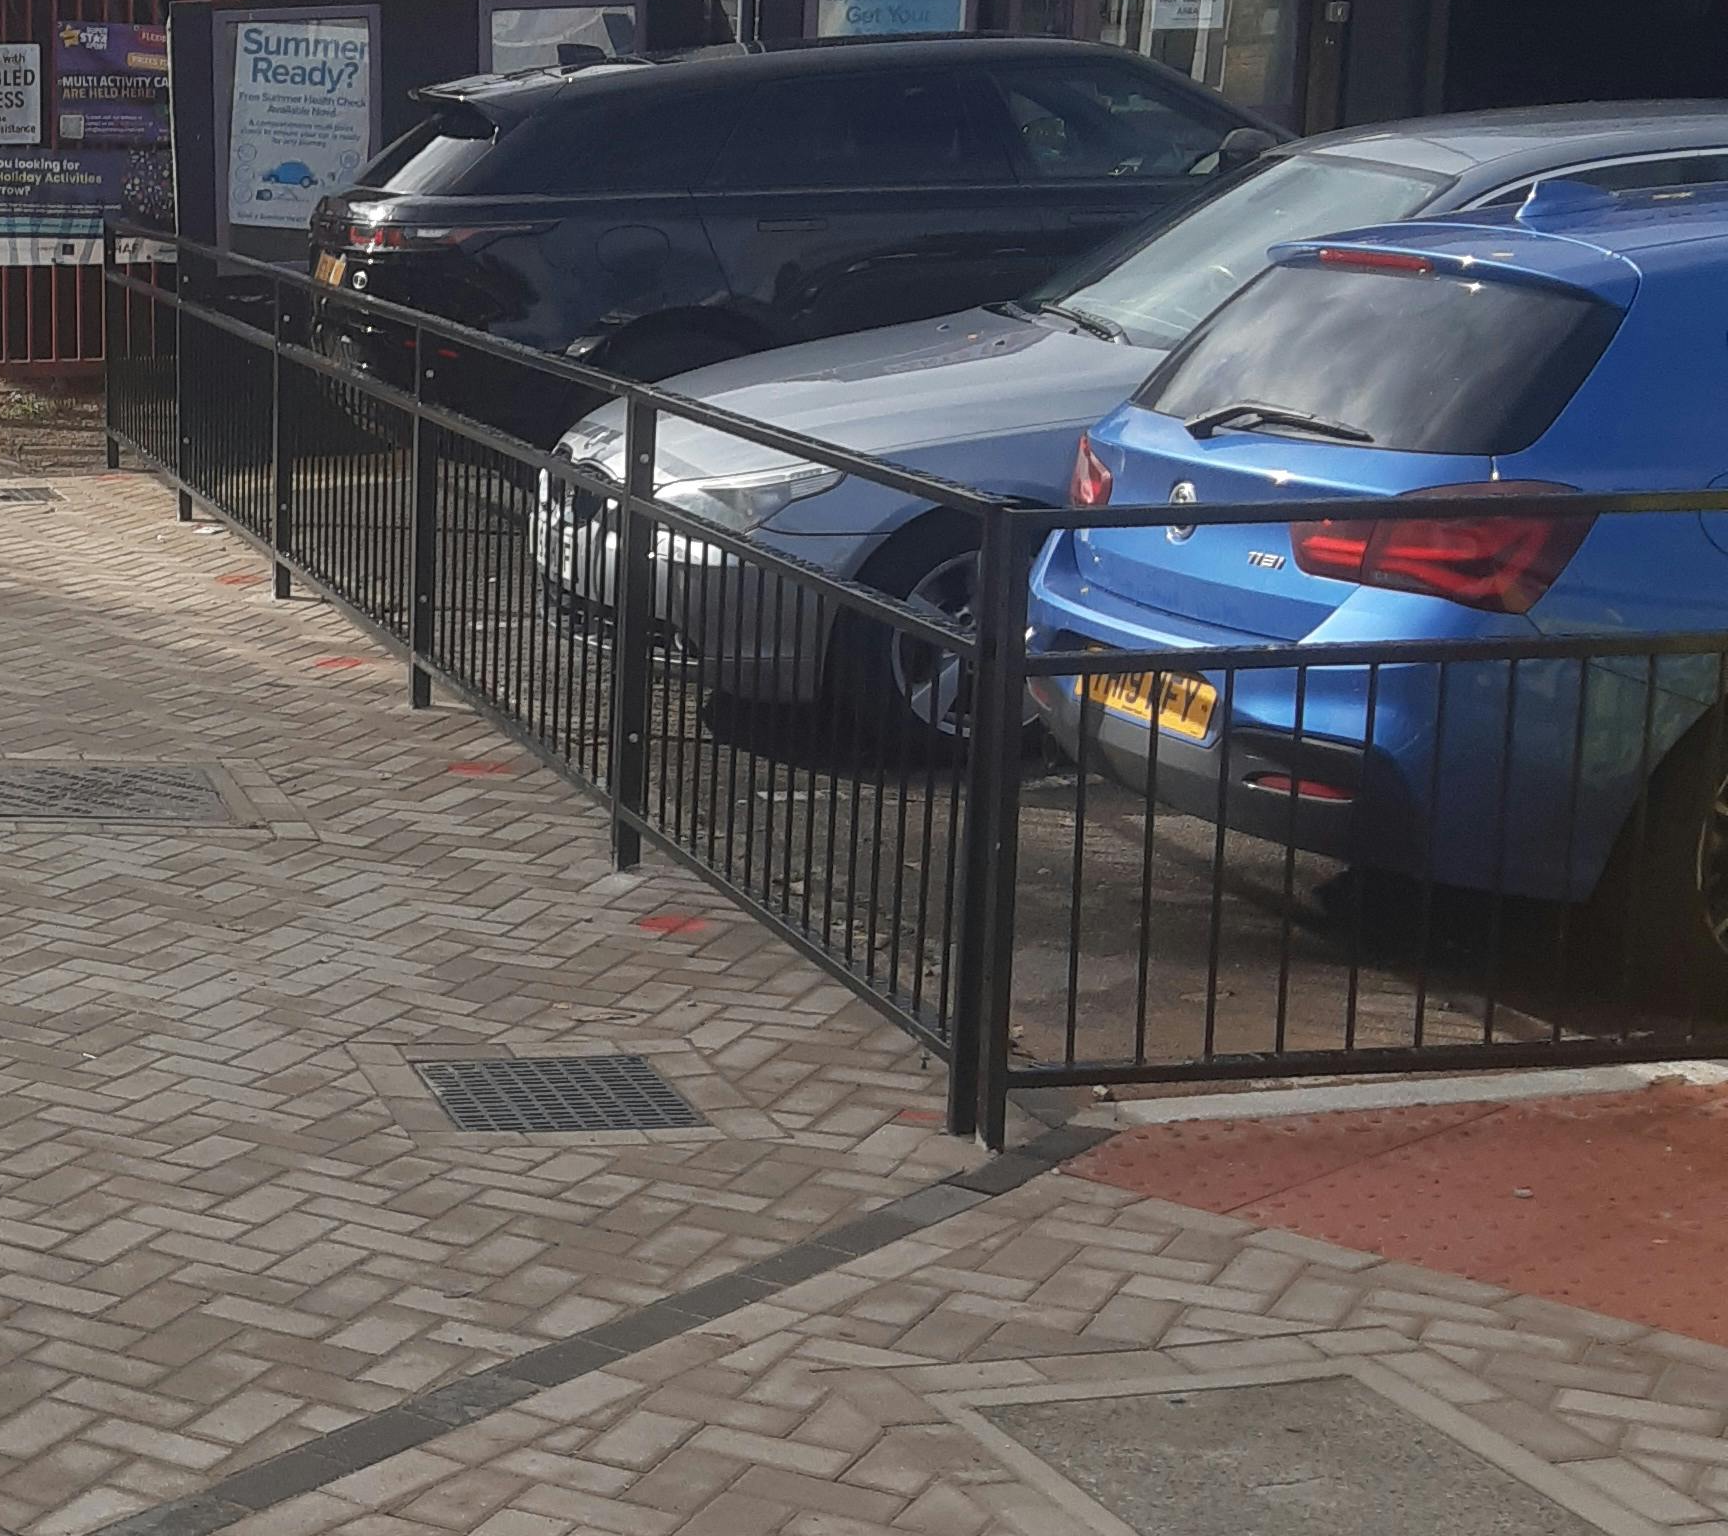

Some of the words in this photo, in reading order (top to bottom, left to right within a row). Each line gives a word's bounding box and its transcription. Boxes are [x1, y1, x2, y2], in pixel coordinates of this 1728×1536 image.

[846, 6, 880, 24] Get
[888, 6, 928, 24] Your
[243, 28, 367, 61] Summer
[3, 53, 25, 65] with
[62, 75, 97, 87] MULTI
[99, 75, 152, 88] ACTIVITY
[251, 57, 359, 94] Ready?
[63, 87, 86, 99] ARE
[89, 87, 118, 99] HELD
[239, 91, 260, 102] Free
[262, 92, 301, 103] Summer
[304, 94, 335, 106] Health
[337, 96, 366, 108] Check
[267, 105, 310, 115] Available
[14, 158, 61, 172] looking
[62, 159, 80, 170] for
[44, 172, 102, 184] Activities
